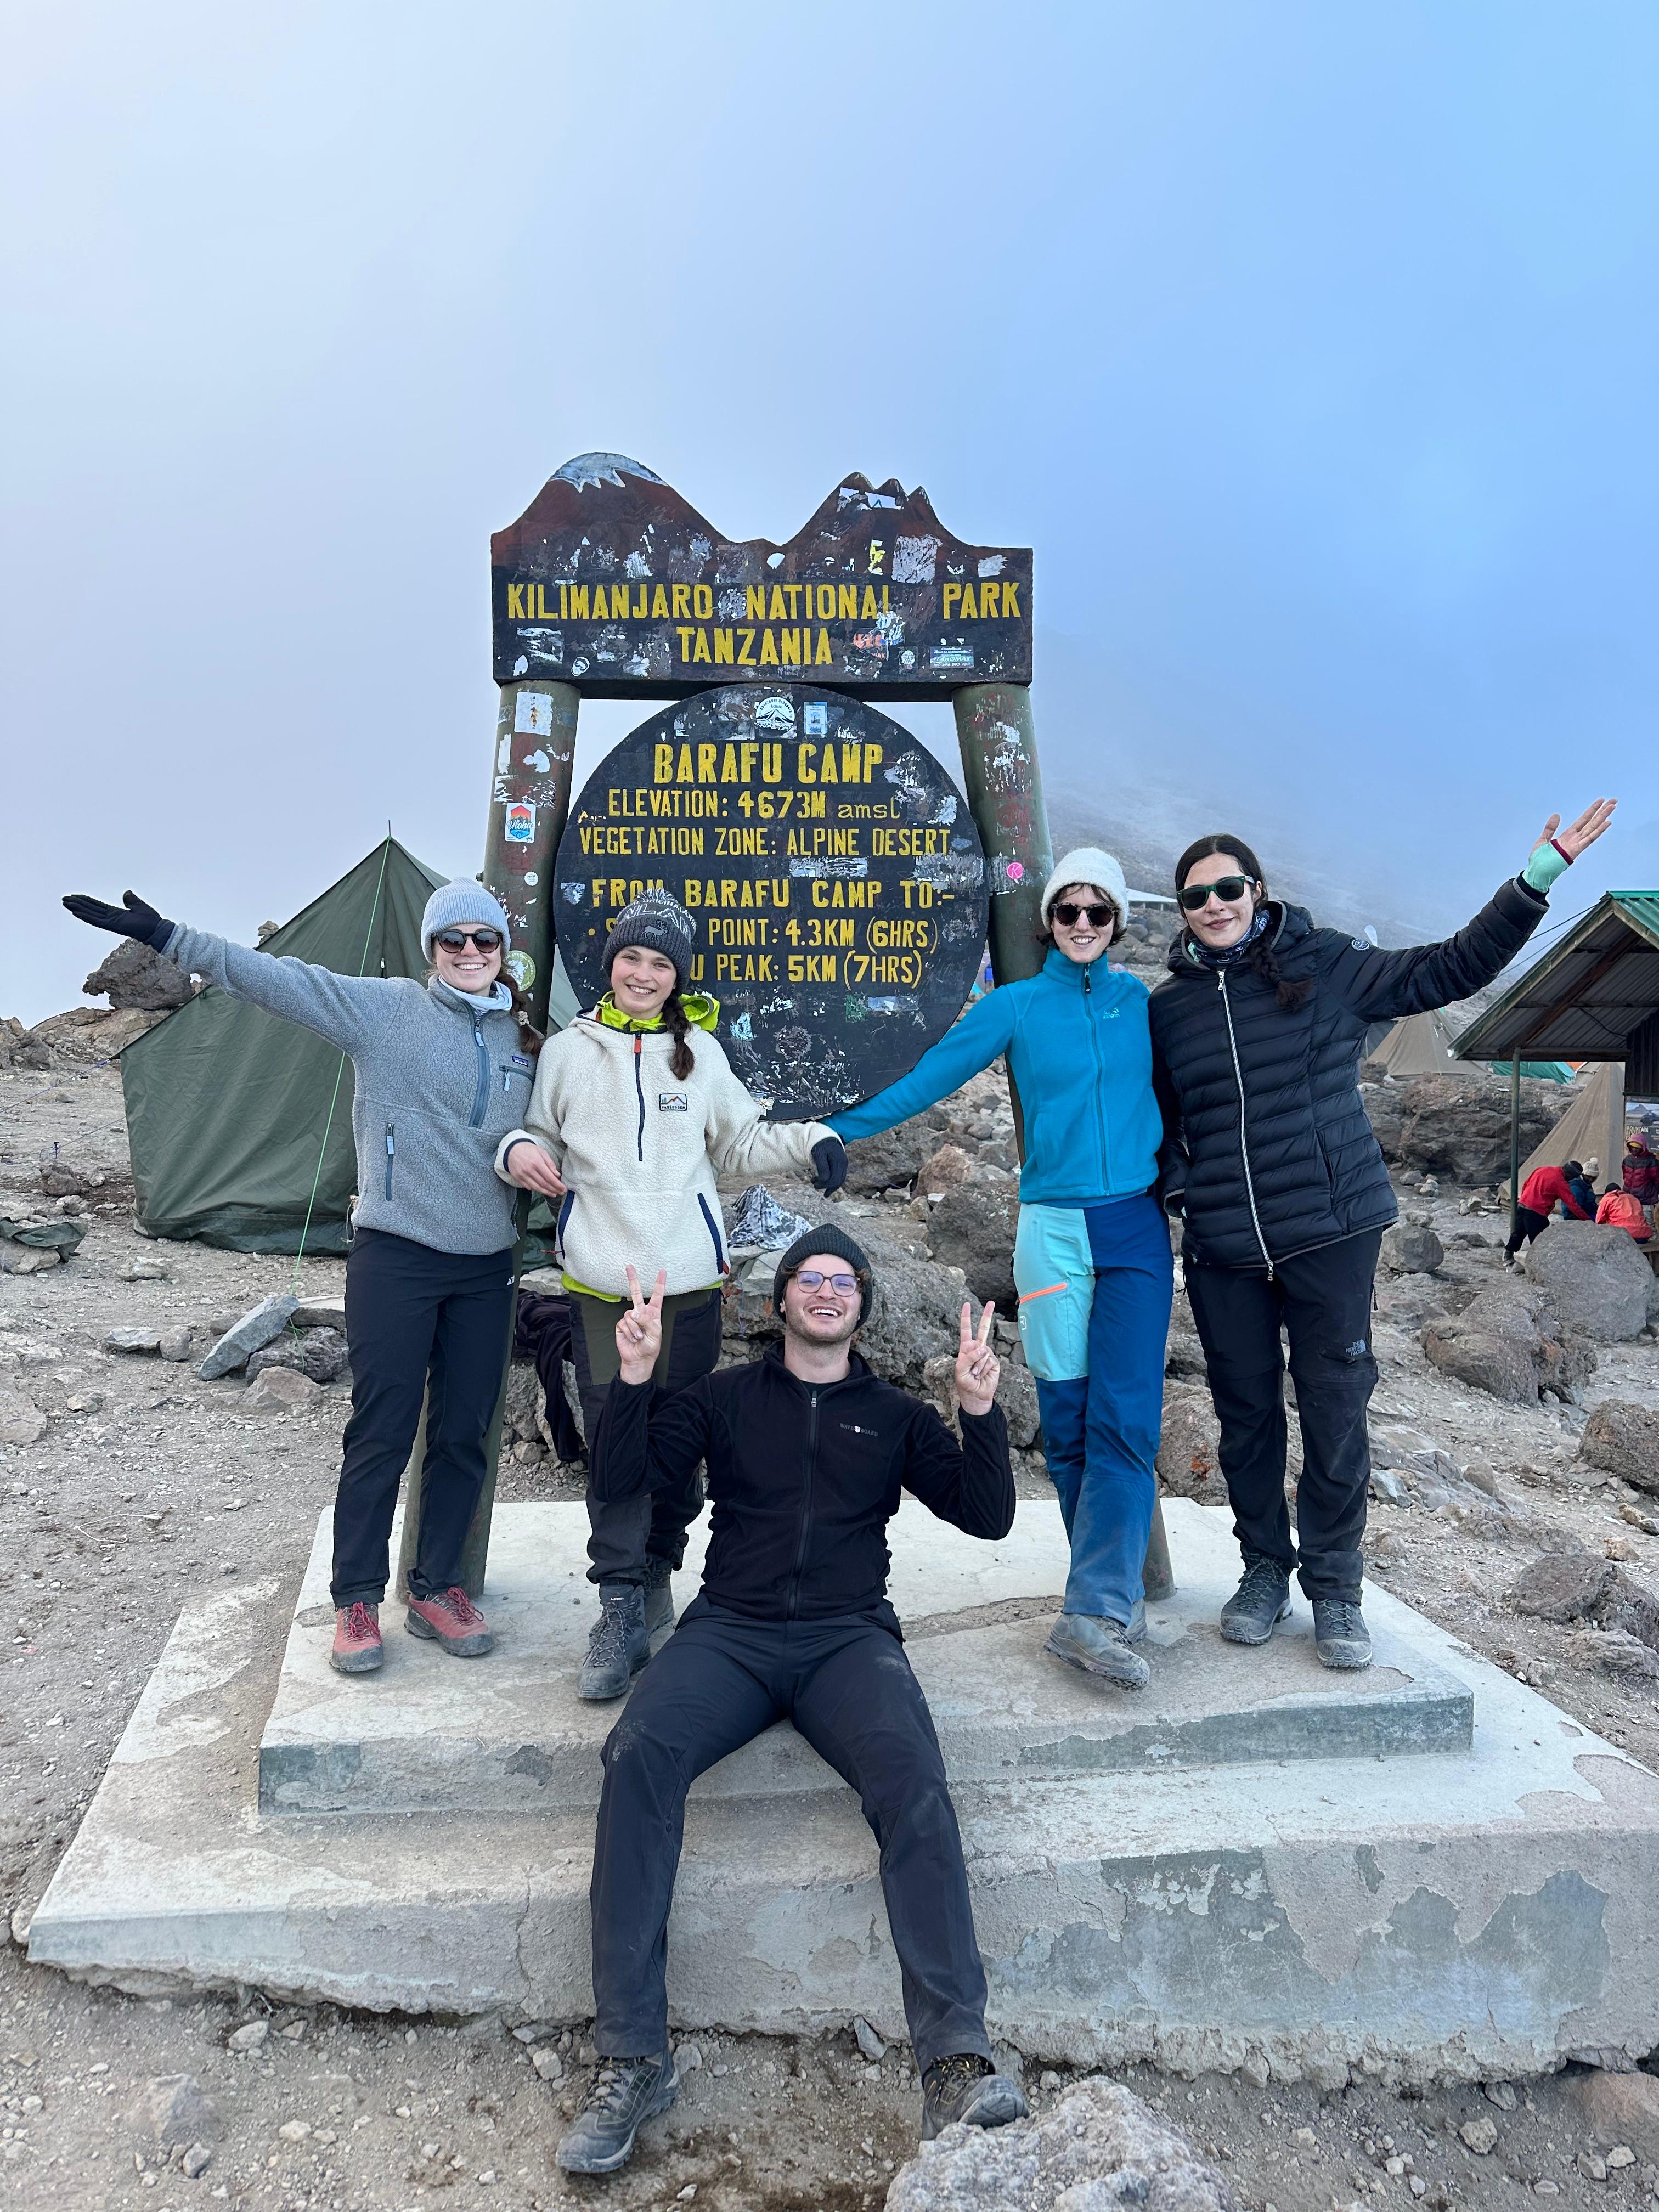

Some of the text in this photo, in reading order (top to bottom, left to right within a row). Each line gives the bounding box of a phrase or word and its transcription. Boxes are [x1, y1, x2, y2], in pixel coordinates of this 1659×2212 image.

[507, 583, 713, 620] KILIMANJARO
[943, 582, 1021, 619] PARK
[676, 627, 833, 665] TANZANIA
[654, 743, 883, 784] BARAFU CAMP
[608, 789, 728, 817] ELEVATION:
[738, 790, 826, 819] 4673M
[579, 827, 951, 856] VEGETATION ZONE: ALPINE DESERT
[685, 879, 790, 908] BARAFU
[812, 881, 882, 909] CAMP
[785, 919, 855, 946] 4.3KM
[866, 916, 938, 955] (6HRS)
[716, 953, 779, 981] PEAK:
[788, 955, 837, 982] 5KM
[844, 950, 922, 991] (7HRS)
[840, 1423, 878, 1437] WAVE BOARD
